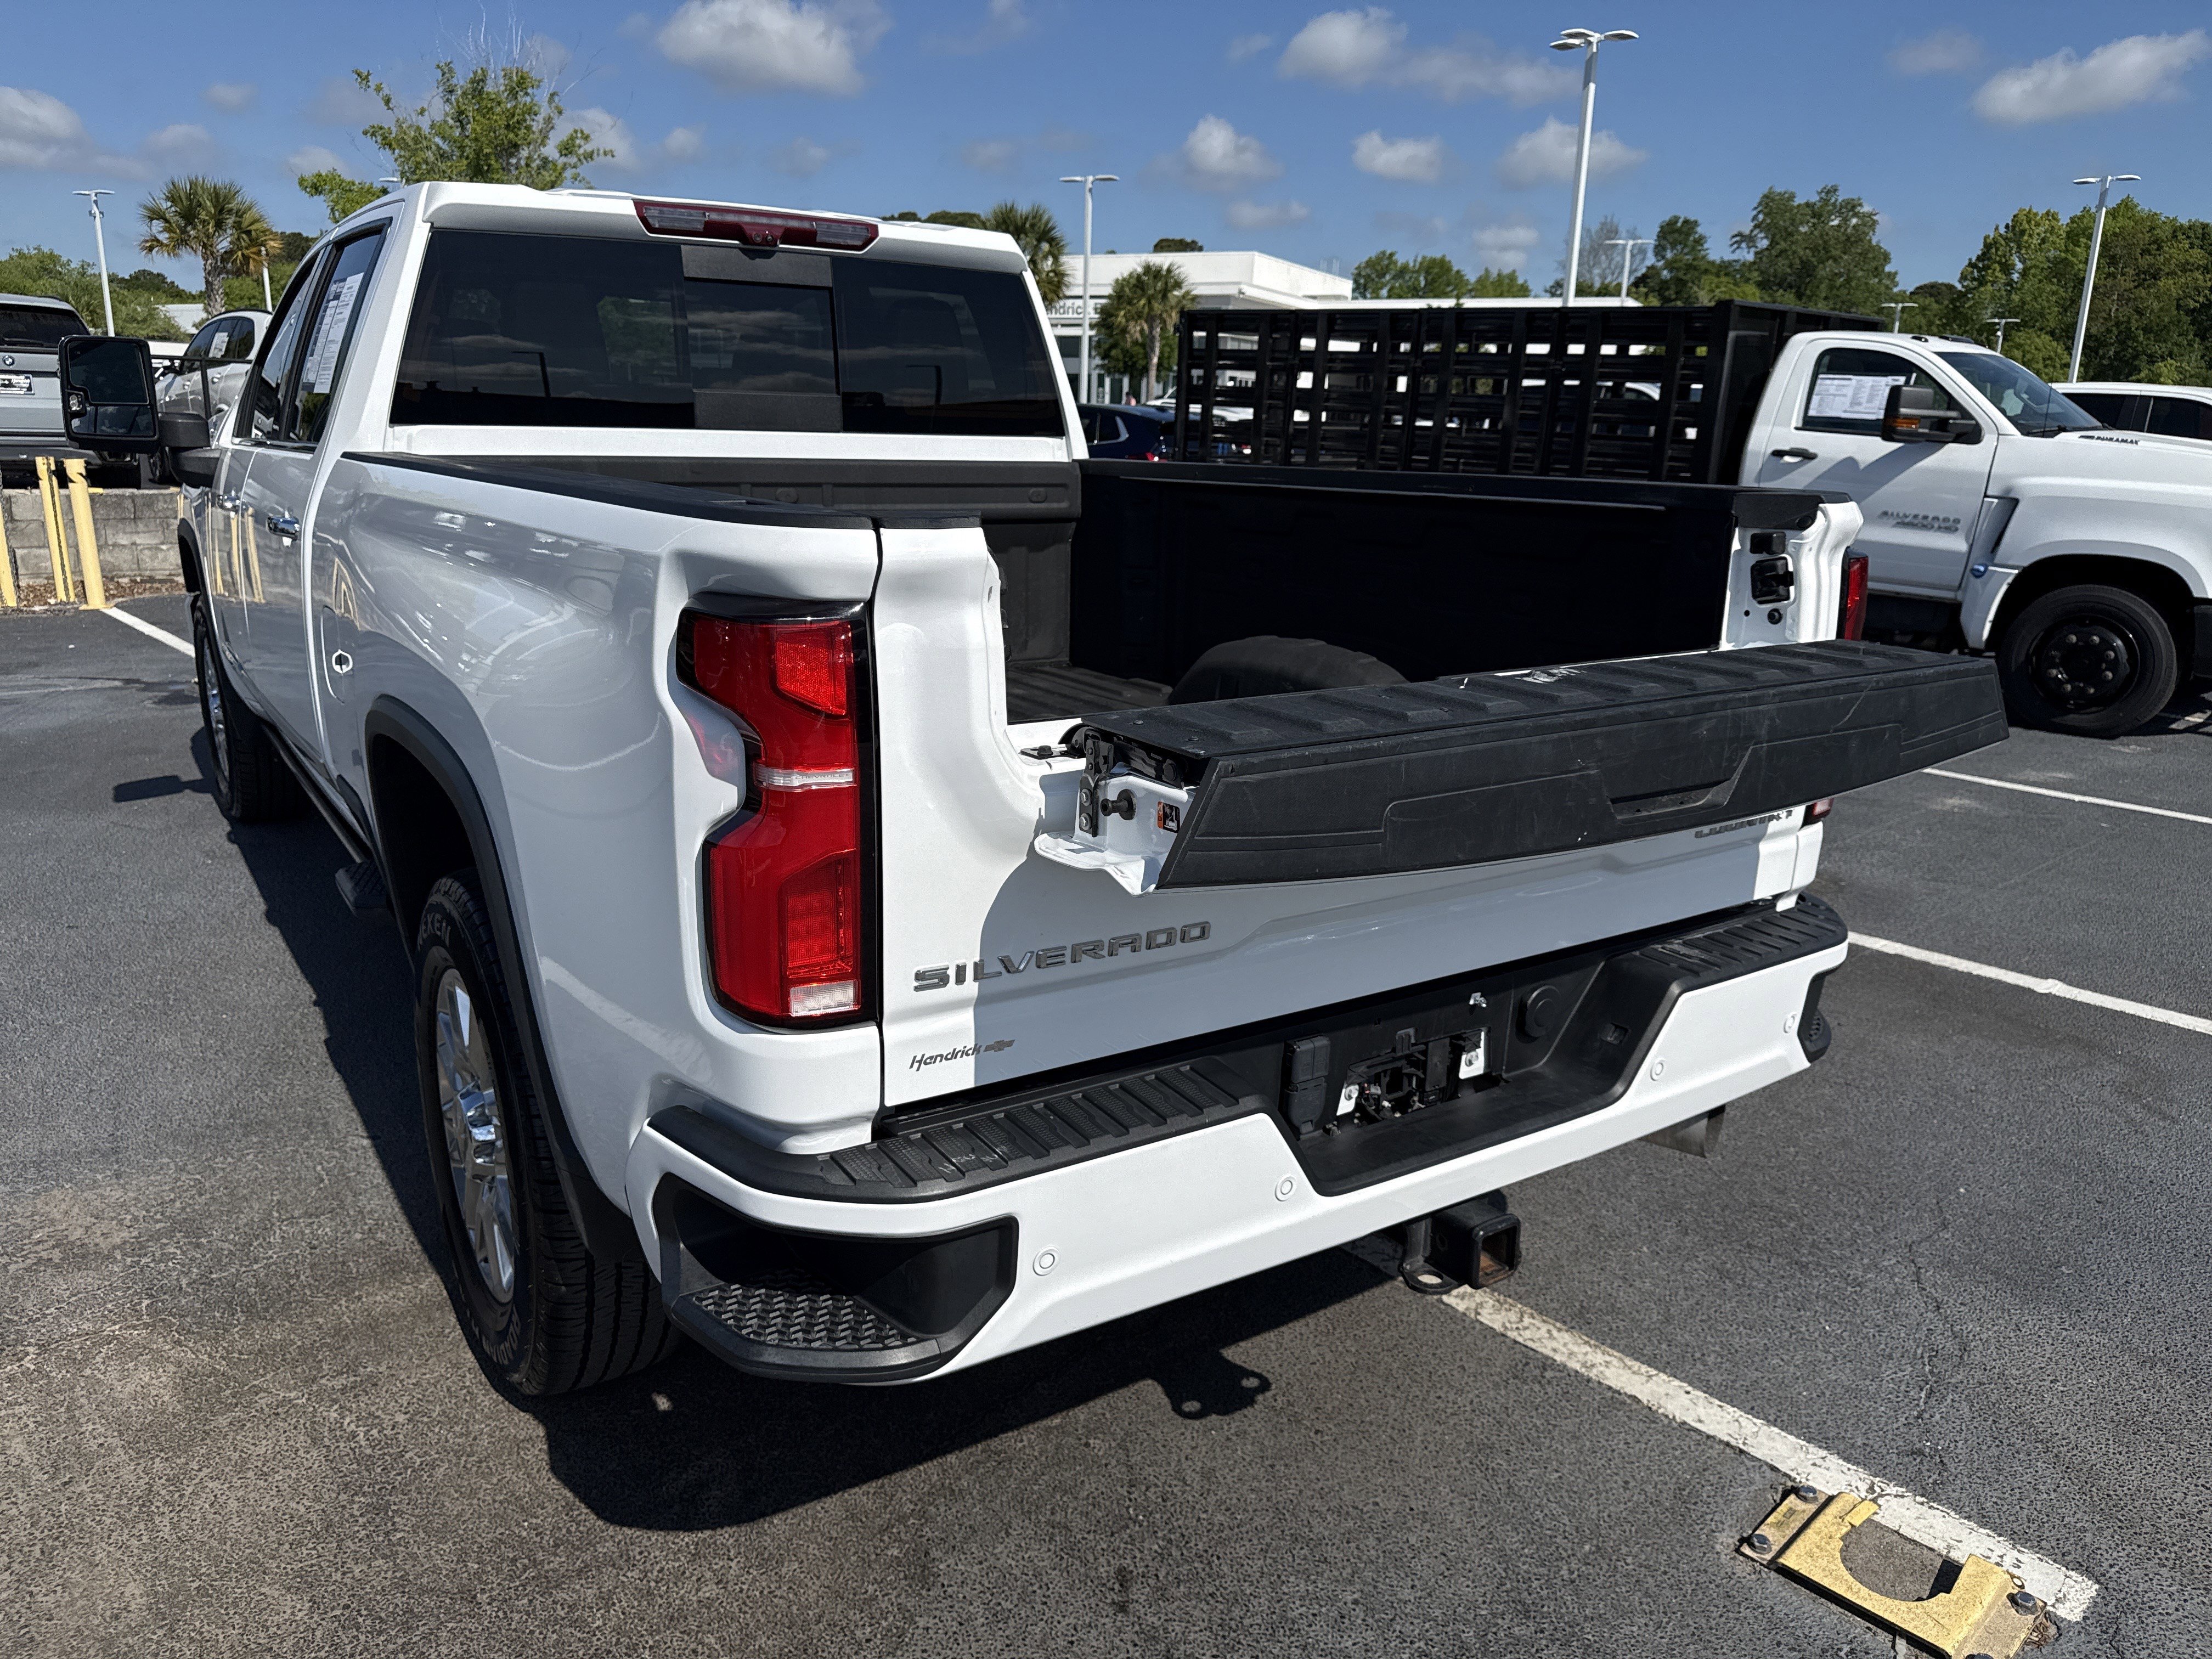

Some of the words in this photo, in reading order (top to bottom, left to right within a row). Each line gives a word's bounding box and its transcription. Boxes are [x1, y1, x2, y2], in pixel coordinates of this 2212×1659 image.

[1877, 510, 1961, 525] SILVERADO
[417, 912, 452, 952] NEXEN
[913, 921, 1211, 992] SILVERADO
[909, 1042, 983, 1071] Hendrick
